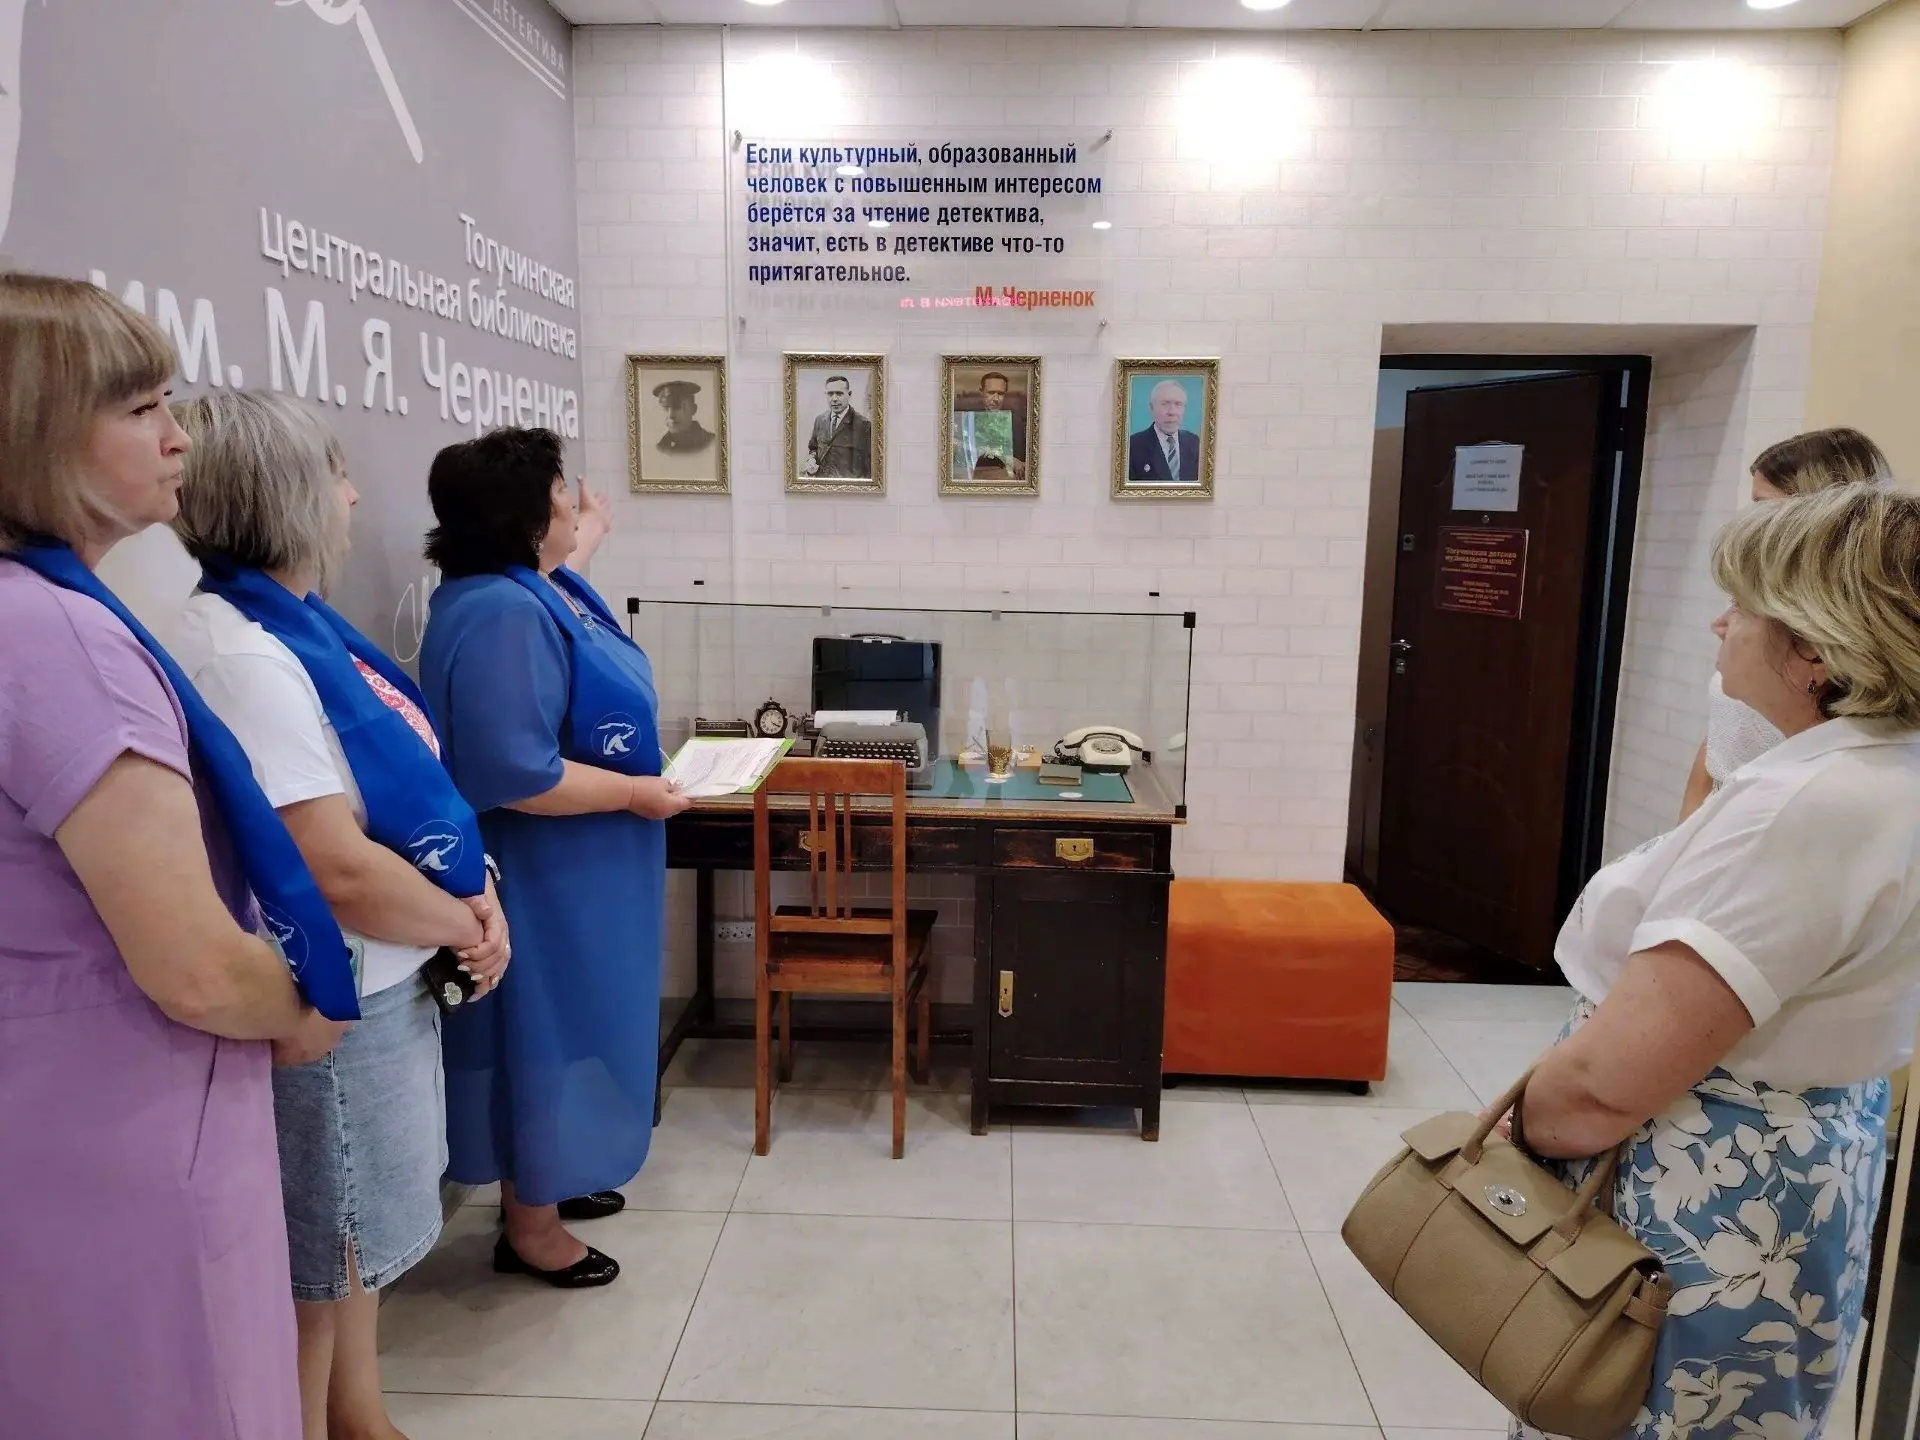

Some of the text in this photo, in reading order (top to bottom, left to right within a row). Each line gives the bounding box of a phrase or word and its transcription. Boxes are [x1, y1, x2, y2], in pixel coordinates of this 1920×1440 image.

[746, 142, 1077, 168] Если культурный, образованный
[747, 176, 1102, 198] человек с повышенным интересом
[748, 202, 1045, 227] берётся за чтение детектива,
[748, 236, 1064, 255] значит, есть в детективе что-то
[459, 212, 575, 309] Тогучинская
[260, 206, 577, 360] центральная библиотека
[748, 265, 910, 285] притягательное.
[975, 286, 1095, 311] М. Черненок
[265, 287, 347, 407] М.
[362, 318, 408, 416] Я.
[419, 331, 579, 440] Черненка
